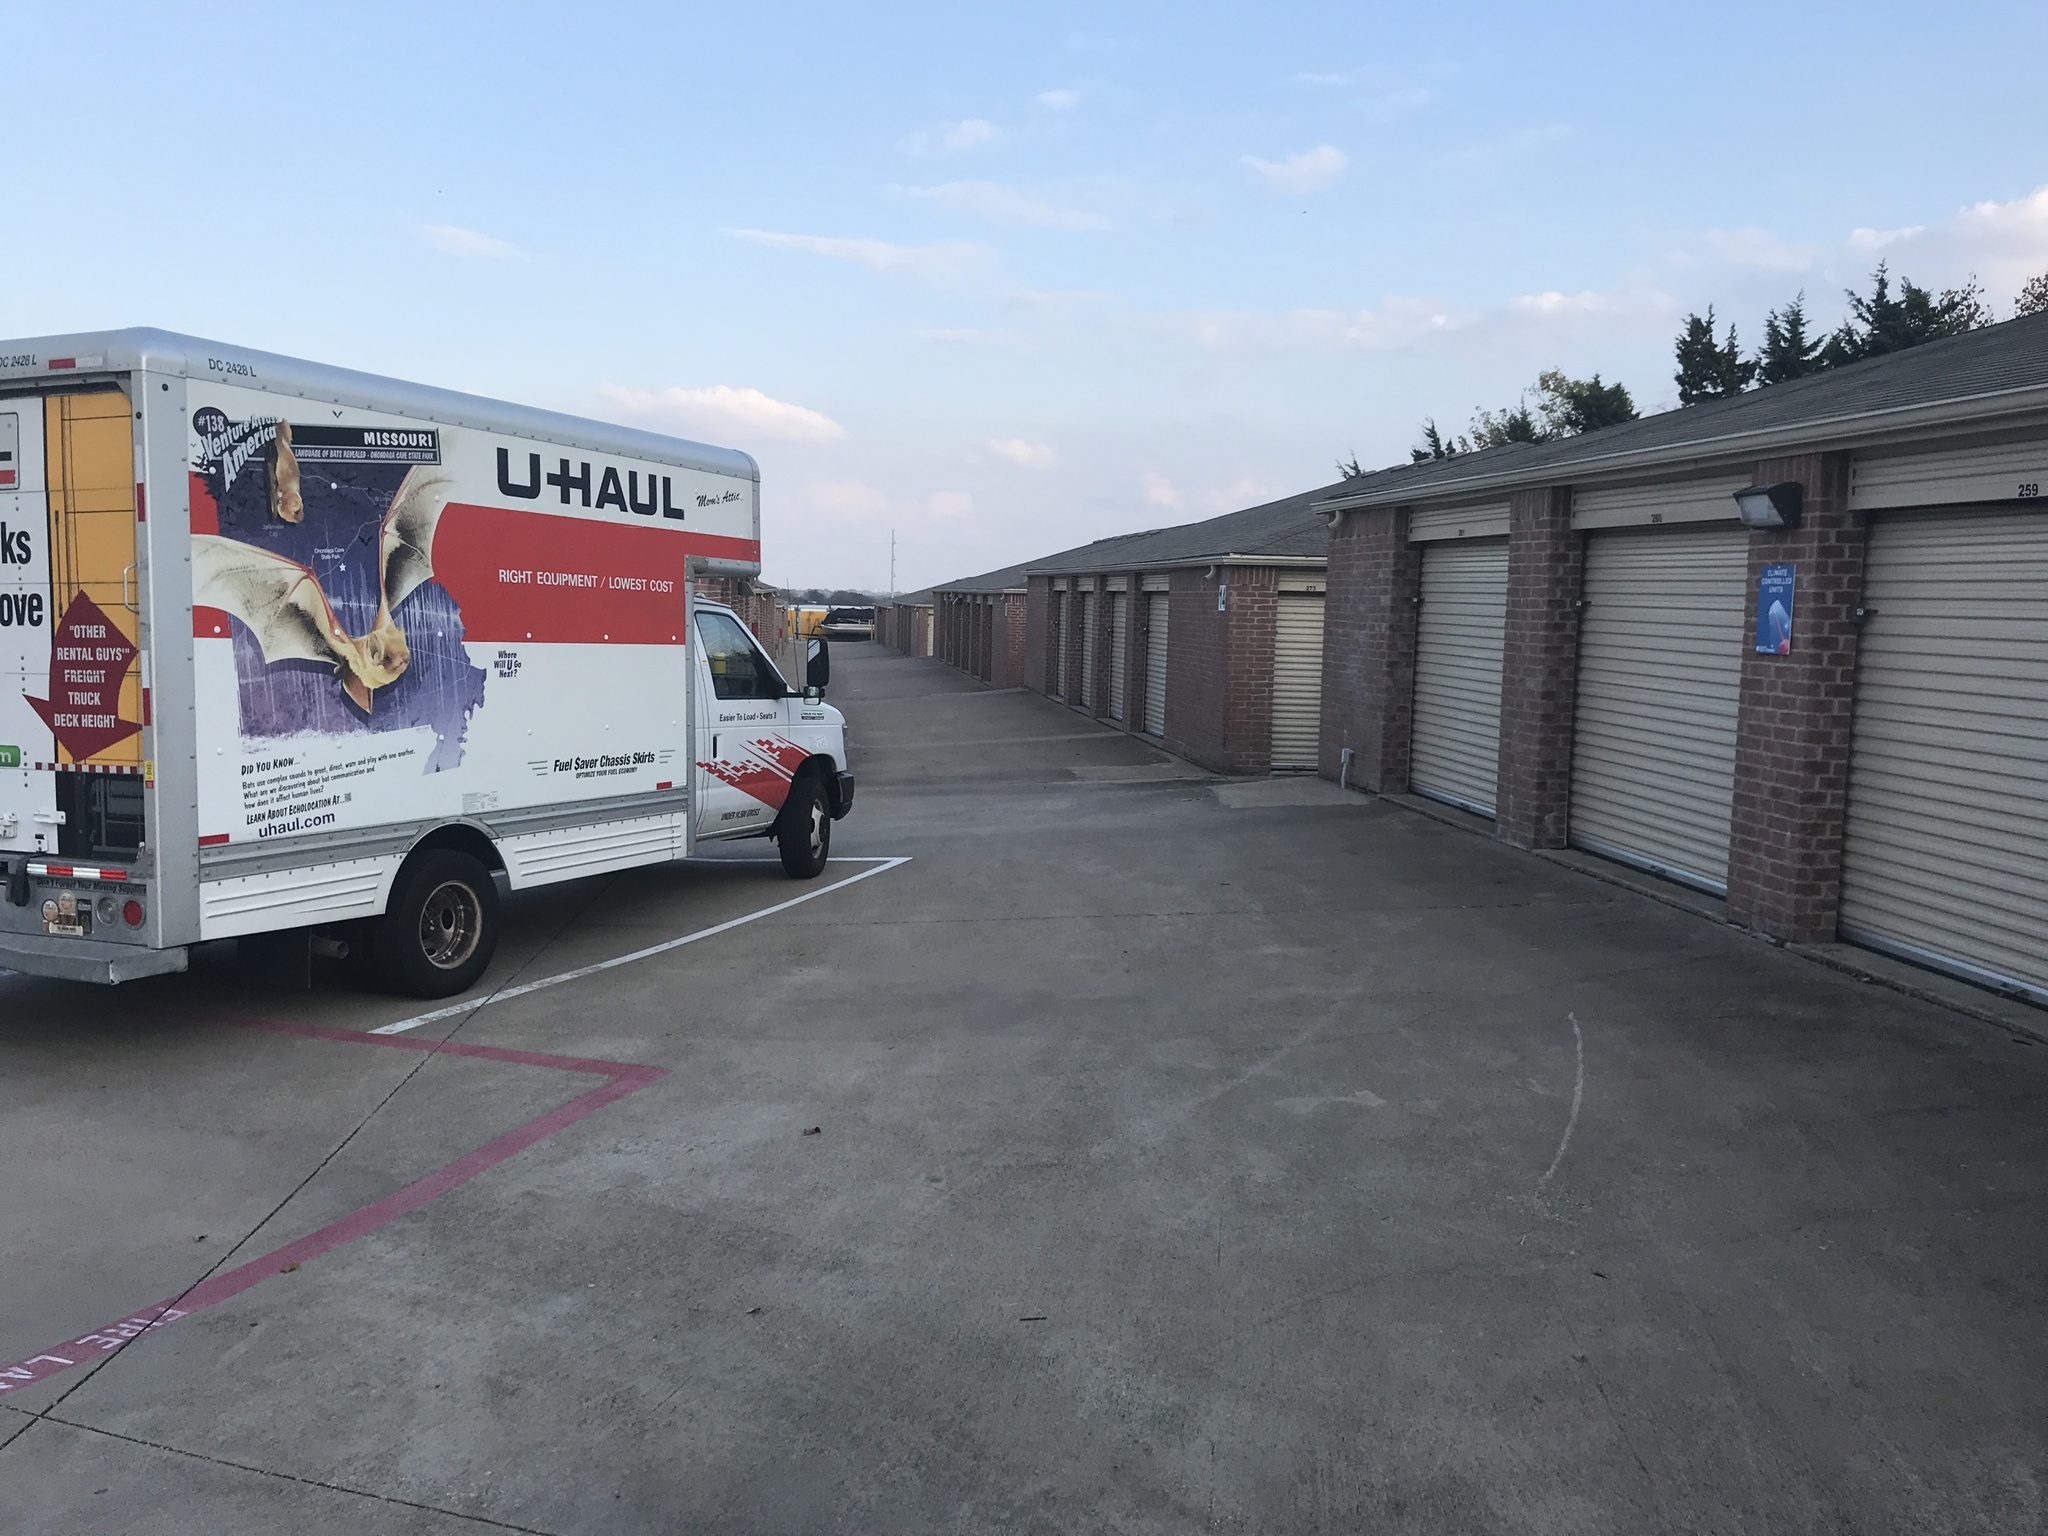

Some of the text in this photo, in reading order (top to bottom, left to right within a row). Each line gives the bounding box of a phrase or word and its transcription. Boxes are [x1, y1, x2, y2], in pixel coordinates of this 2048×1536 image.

[10, 355, 30, 367] 2428
[32, 354, 37, 365] L
[208, 358, 257, 377] DC 2428 L
[198, 415, 225, 432] #138
[201, 414, 283, 461] Venture Across
[364, 432, 432, 447] MISSOURI
[222, 425, 277, 493] America
[295, 449, 321, 458] LANGUAGE
[322, 450, 330, 458] OF
[330, 450, 342, 458] BATS
[343, 450, 366, 459] REVEALED
[396, 452, 408, 460] CAVE
[408, 452, 422, 460] STATE
[2018, 484, 2038, 497] 259
[696, 490, 740, 507] Mom's Attic
[1767, 569, 1788, 577] CLIMATE
[498, 569, 533, 584] RIGHT
[537, 571, 598, 588] EQUIPMENT
[609, 576, 647, 591] LOWEST
[650, 580, 674, 593] COST
[69, 625, 106, 639] "OTHER
[56, 647, 93, 661] RENTAL
[498, 650, 517, 659] Where
[494, 660, 522, 670] Will U Go
[64, 669, 106, 684] FREIGHT
[499, 669, 518, 678] Next?
[68, 692, 101, 706] TRUCK
[54, 714, 116, 728] DECK HEIGHT
[720, 713, 736, 722] Easier
[736, 713, 742, 721] To
[744, 712, 756, 720] Load
[760, 712, 772, 720] Seats
[241, 765, 254, 776] DID
[256, 761, 271, 773] YOU
[554, 758, 573, 772] Fuel
[600, 754, 631, 768] Chassis
[632, 752, 656, 764] Skirts
[242, 781, 256, 790] Bats
[267, 775, 288, 785] complex
[289, 770, 306, 781] sounds
[358, 756, 366, 765] and
[367, 756, 377, 765] play
[378, 753, 388, 761] with
[576, 766, 638, 779] OPTIMIZE YOUR FUEL ECONOMY
[244, 790, 258, 800] What
[278, 781, 306, 792] discovering
[307, 777, 320, 786] about
[331, 768, 365, 781] communication
[366, 765, 375, 774] and
[244, 802, 256, 810] how
[257, 799, 269, 807] does
[276, 794, 290, 802] affect
[292, 790, 308, 798] human
[310, 784, 324, 796] lives?
[246, 812, 266, 825] LEARN
[267, 807, 288, 820] ABOUT
[289, 798, 332, 816] ECHOLOCATION
[258, 812, 336, 838] uhaul.com
[75, 1307, 188, 1350] FIRE
